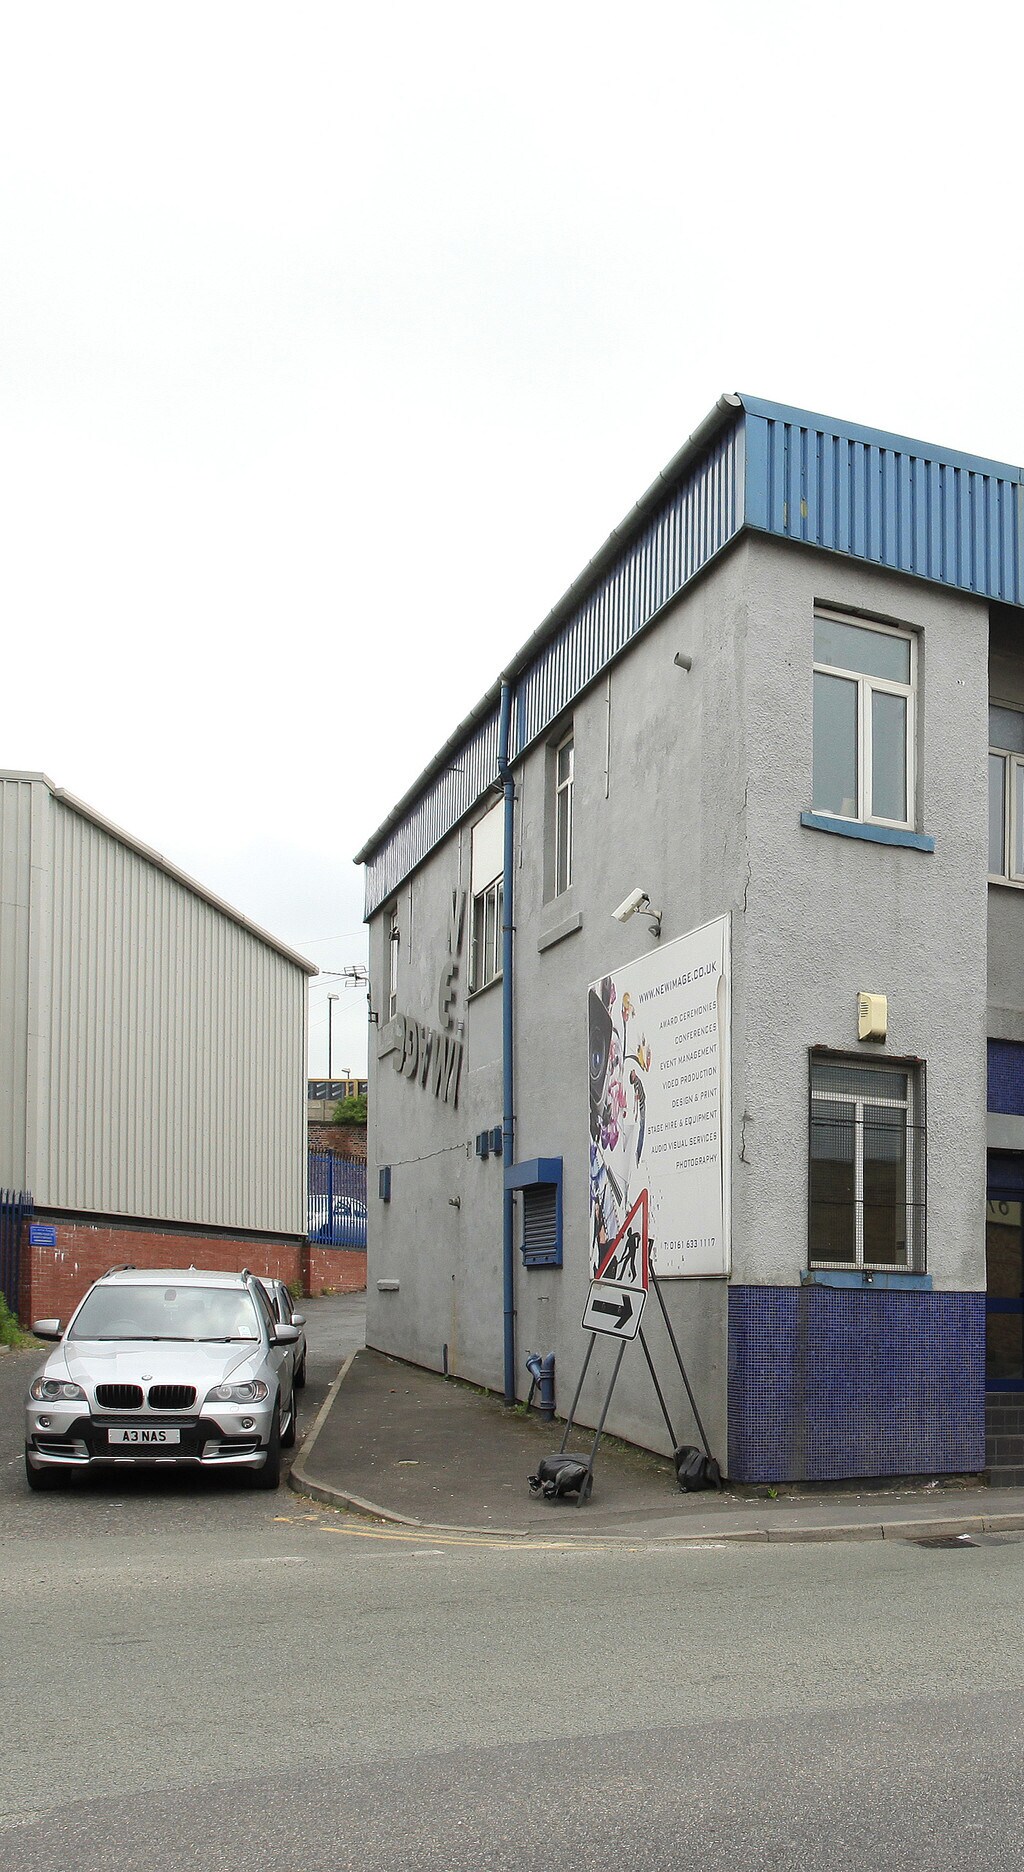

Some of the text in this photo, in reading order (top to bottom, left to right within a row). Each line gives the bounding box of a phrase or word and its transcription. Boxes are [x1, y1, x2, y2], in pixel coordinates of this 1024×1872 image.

[638, 960, 717, 1004] WWW.NEWIMAGE.CO.UK
[659, 1000, 717, 1030] AWARD CEREMONIES
[674, 1022, 717, 1045] CONFERENCES
[660, 1043, 718, 1071] EVENT MANAGEMENT
[662, 1066, 717, 1090] VIDEO PRODUCTION
[671, 1087, 718, 1109] DESIGN & PRINT
[647, 1109, 718, 1135] STAGE HIRE & EQUIPMENT
[651, 1131, 717, 1154] AUDIO VISUAL SERVICES
[675, 1153, 718, 1170] PHOTOGRAPHY
[122, 1430, 167, 1442] A3 NAS
